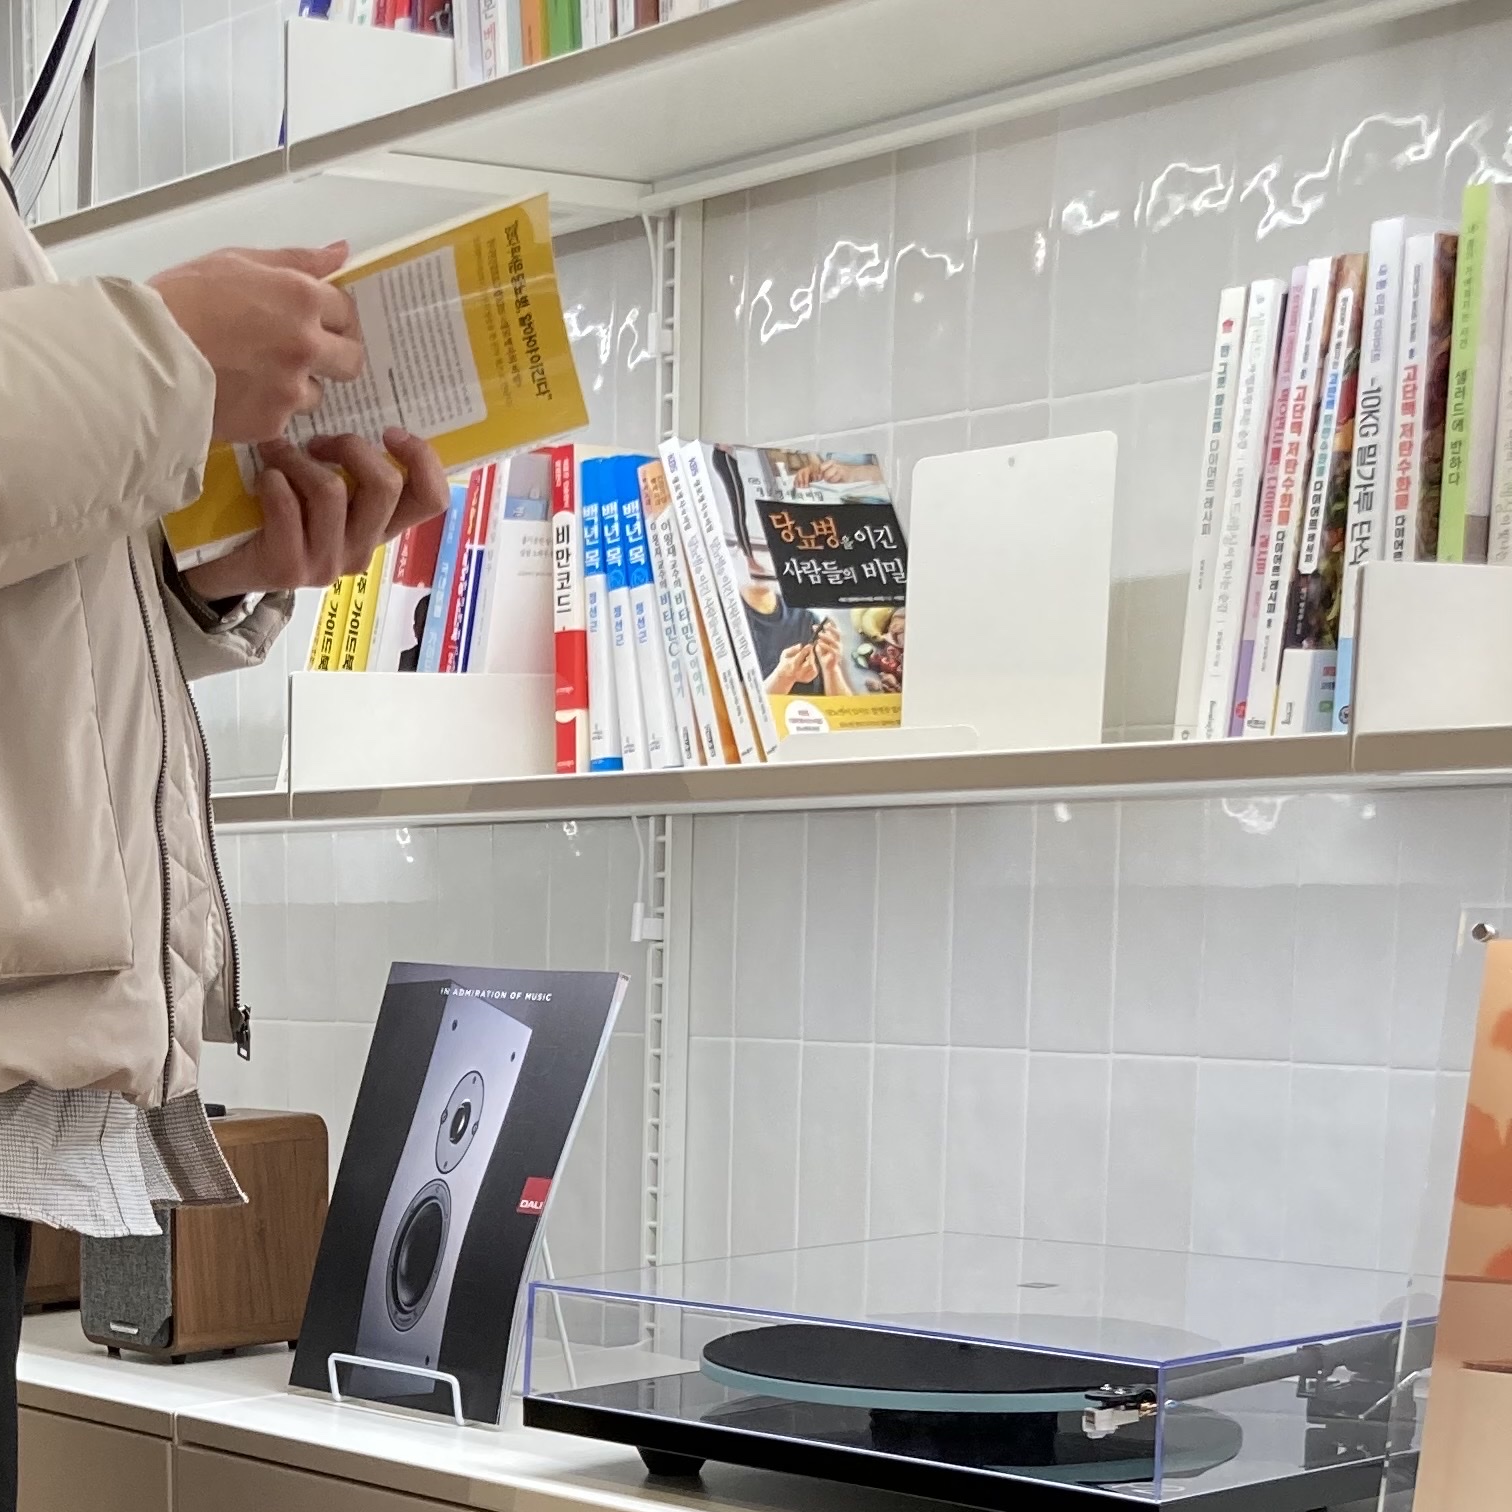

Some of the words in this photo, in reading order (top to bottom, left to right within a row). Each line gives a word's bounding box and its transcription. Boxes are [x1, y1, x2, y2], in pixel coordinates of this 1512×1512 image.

[1358, 377, 1382, 438] -10KG
[1205, 439, 1221, 493] 다이어트
[1352, 443, 1377, 515] 밀가루
[1201, 496, 1216, 536] 레시피
[1308, 481, 1324, 530] 다이어트
[768, 511, 854, 550] 당뇨병을
[854, 525, 897, 550] 이긴
[1270, 530, 1286, 577] 다이어트
[1348, 520, 1372, 567] 단식
[555, 524, 572, 614] 비만코드
[782, 557, 858, 585] 사람들의
[861, 557, 907, 585] 비밀
[1266, 579, 1280, 614] 레시피
[342, 599, 364, 671] 가이드북
[439, 987, 450, 995] IN
[452, 989, 508, 999] ADMIRATION
[509, 991, 523, 1000] OF
[524, 992, 553, 1002] MUSIC
